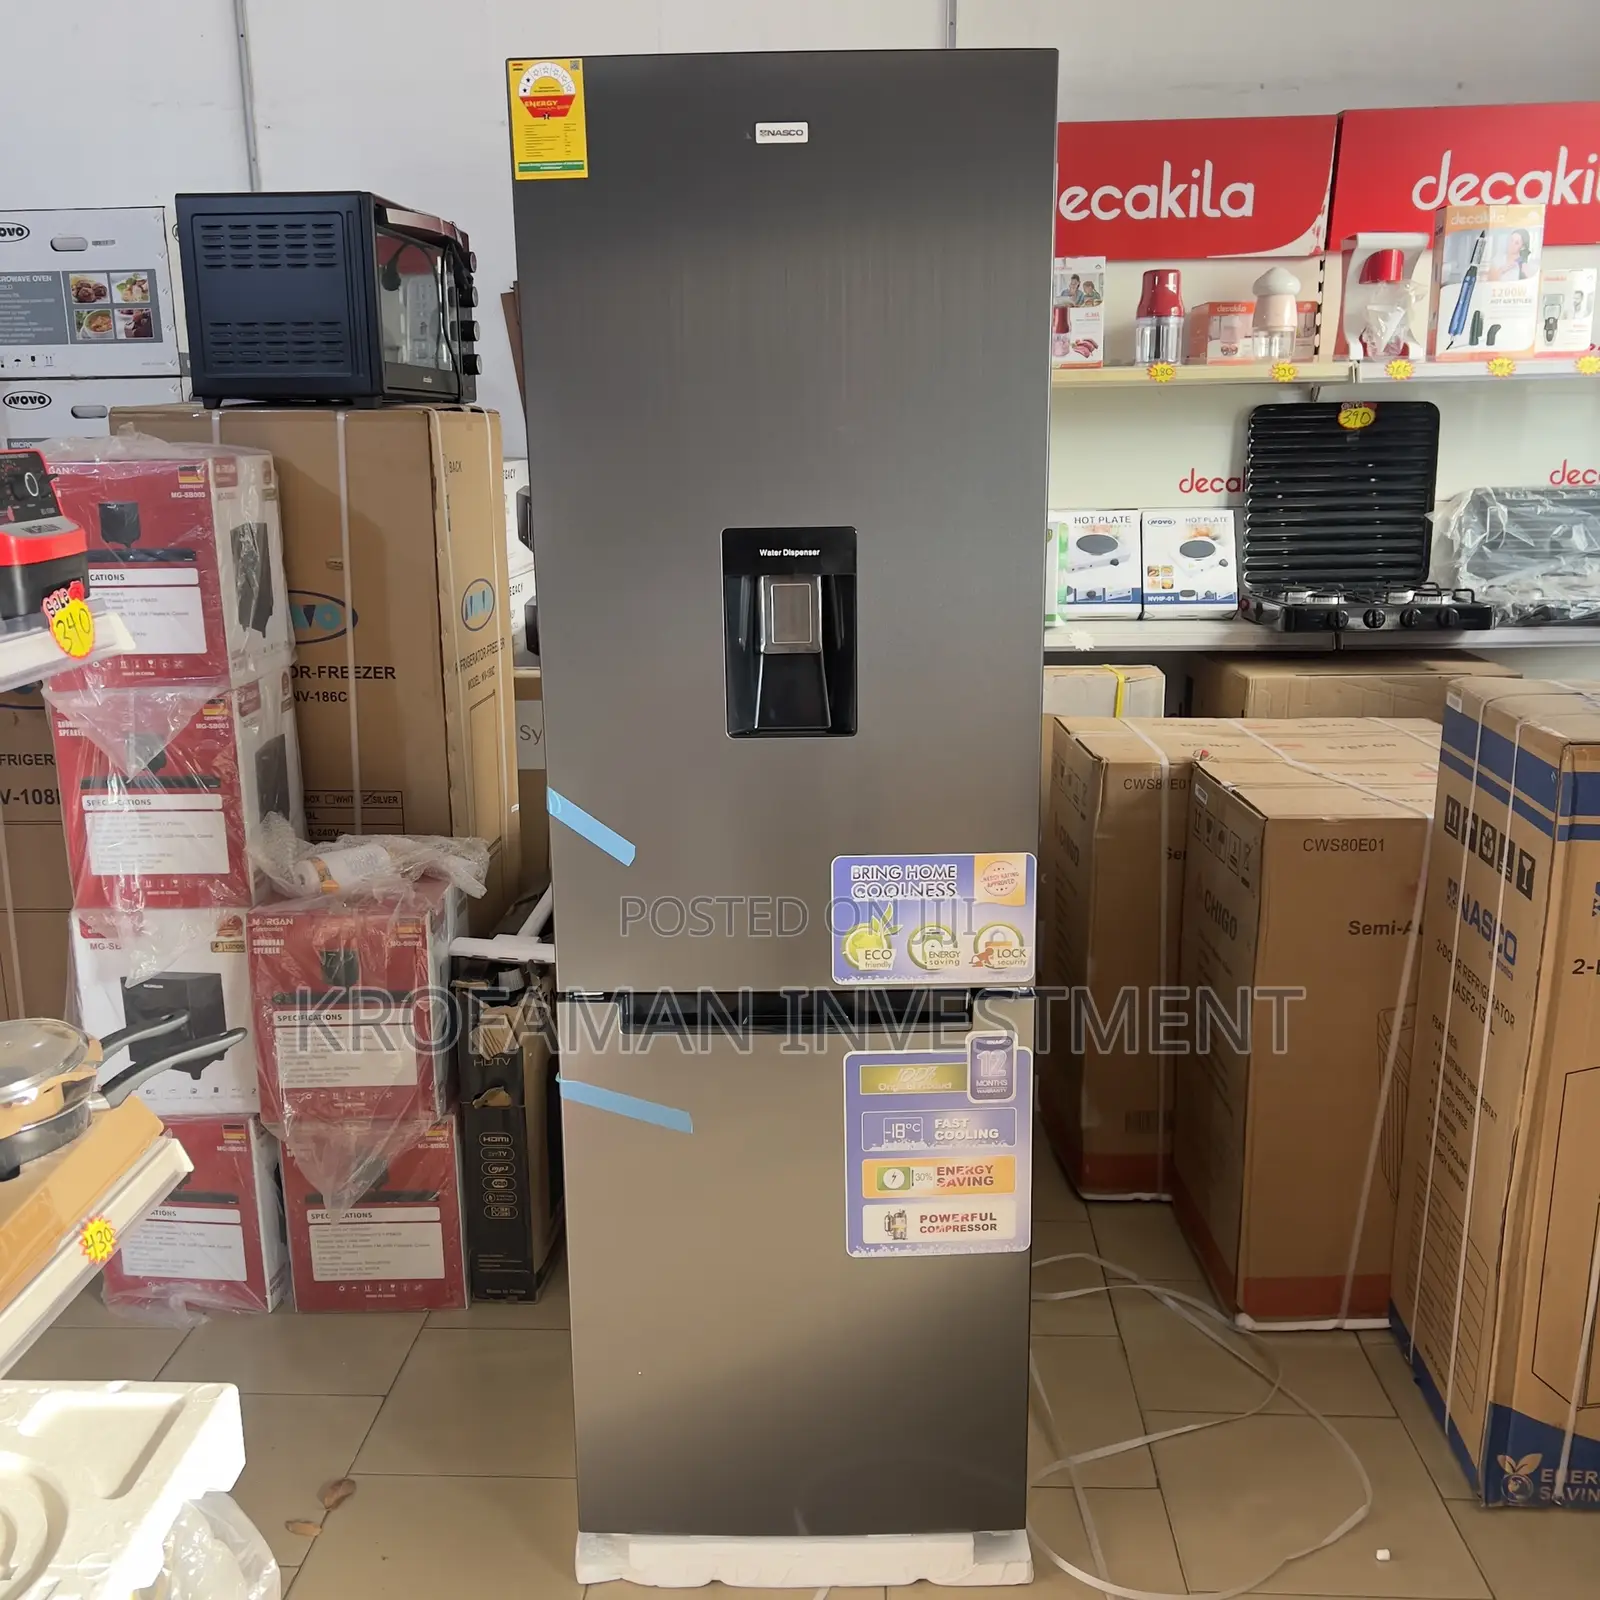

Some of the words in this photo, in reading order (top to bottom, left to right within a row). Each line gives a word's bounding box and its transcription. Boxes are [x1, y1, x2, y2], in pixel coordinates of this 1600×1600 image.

[767, 129, 804, 137] NASCO
[1411, 145, 1600, 211] decaki
[1057, 159, 1255, 221] ecakila
[8, 395, 47, 405] NOVO
[1342, 410, 1372, 426] 390
[1549, 459, 1600, 487] dec
[1074, 516, 1096, 525] HOT
[1098, 515, 1132, 524] PLATE
[759, 548, 782, 557] Water
[782, 548, 821, 559] Dispenser
[45, 590, 70, 618] Sale
[56, 608, 92, 654] 340
[1123, 777, 1191, 791] CWS8E0
[1302, 838, 1385, 852] CWS80E01
[851, 864, 903, 881] BRING
[905, 863, 958, 880] HOME
[852, 881, 958, 900] COOLNESS
[252, 917, 294, 926] MORGAN
[1203, 889, 1239, 942] CHIGO
[1347, 920, 1425, 936] Semi-A
[864, 949, 893, 960] ECO
[928, 950, 961, 959] ENERGY
[996, 948, 1027, 959] LOCK
[864, 960, 893, 969] friendly
[928, 959, 961, 967] saving
[996, 957, 1028, 967] security
[1571, 958, 1600, 975] 2-
[277, 1013, 343, 1022] SPECIFICATIONS
[473, 1057, 512, 1067] HDTV
[976, 1049, 1008, 1077] 12
[976, 1079, 1008, 1087] MONTHS
[934, 1118, 970, 1130] FAST
[934, 1129, 999, 1142] COOLING
[915, 1171, 933, 1182] 30%
[936, 1164, 994, 1177] ENERGY
[936, 1176, 994, 1188] SAVING
[919, 1212, 997, 1224] POWERFUL
[919, 1223, 998, 1234] COMPRESSOR
[85, 1226, 113, 1258] 430
[1540, 1468, 1600, 1486] EER
